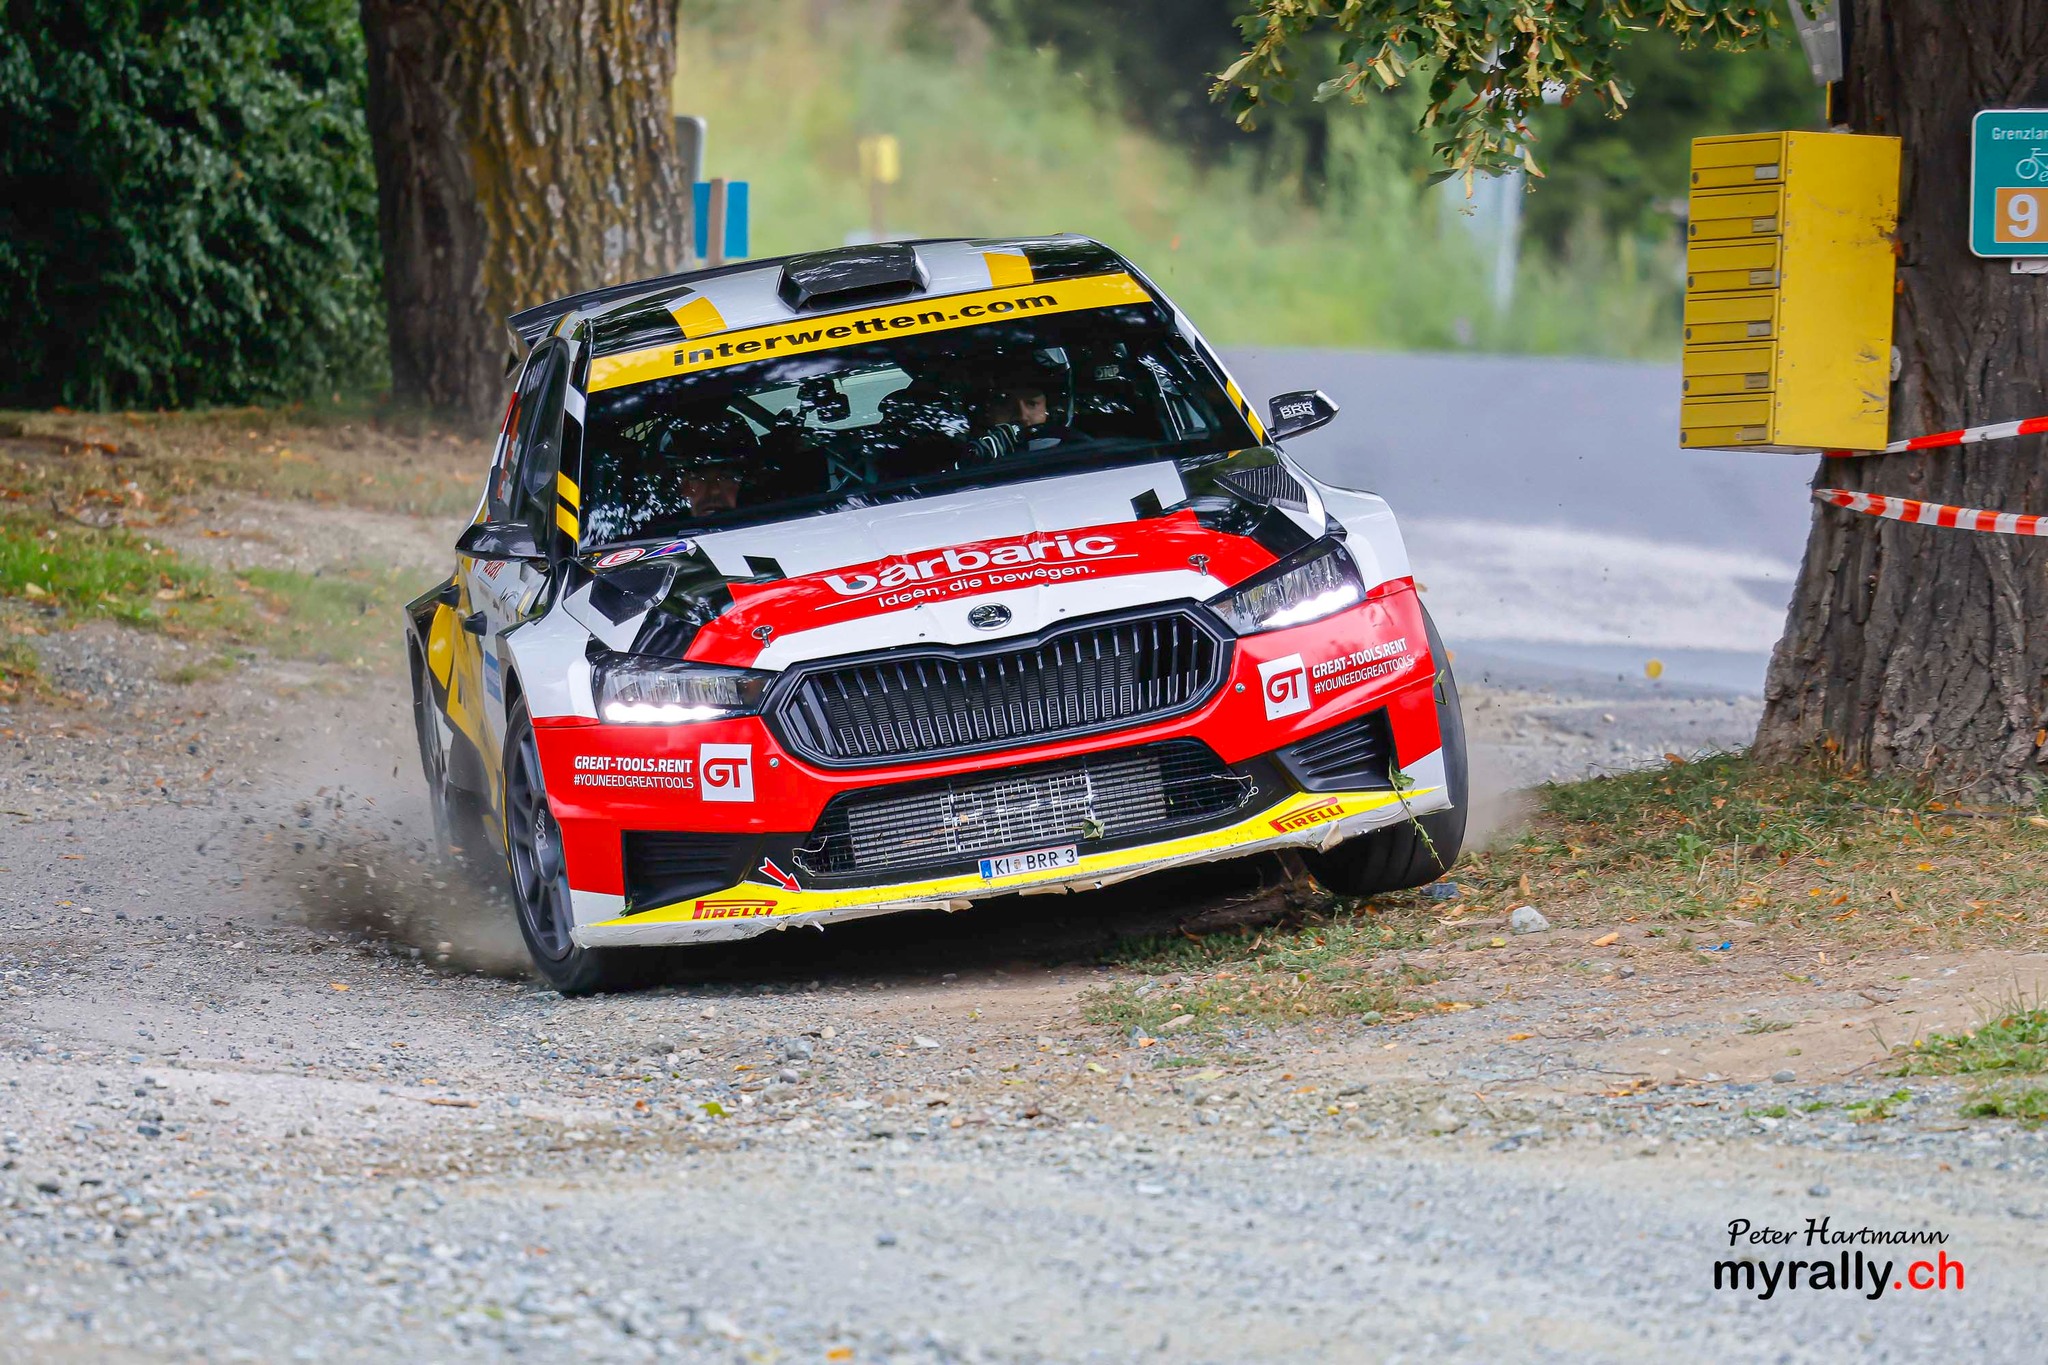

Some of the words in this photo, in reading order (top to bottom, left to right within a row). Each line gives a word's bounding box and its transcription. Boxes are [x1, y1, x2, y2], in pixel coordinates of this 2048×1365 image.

[2008, 194, 2038, 238] 9
[673, 291, 1060, 366] interwetten.com
[1281, 403, 1315, 419] BRR
[823, 536, 1117, 596] barbaric
[878, 584, 947, 608] Ideen,
[950, 577, 982, 593] die
[989, 563, 1097, 586] bewegen.
[1266, 667, 1304, 704] GT
[1312, 637, 1408, 679] GREAT-TOOLS.RENT
[1314, 654, 1415, 695] #YOUNEEDGREATTOOLS
[573, 774, 694, 789] #YOUNEEDGREATTOOLS
[574, 755, 693, 773] GREAT-TOOLS.RENT
[703, 757, 748, 788] GT
[1269, 797, 1345, 833] PIRELLI
[995, 858, 1010, 875] KI
[1026, 851, 1059, 870] BRR
[1065, 848, 1075, 863] 3
[692, 900, 778, 919] PIRELLI
